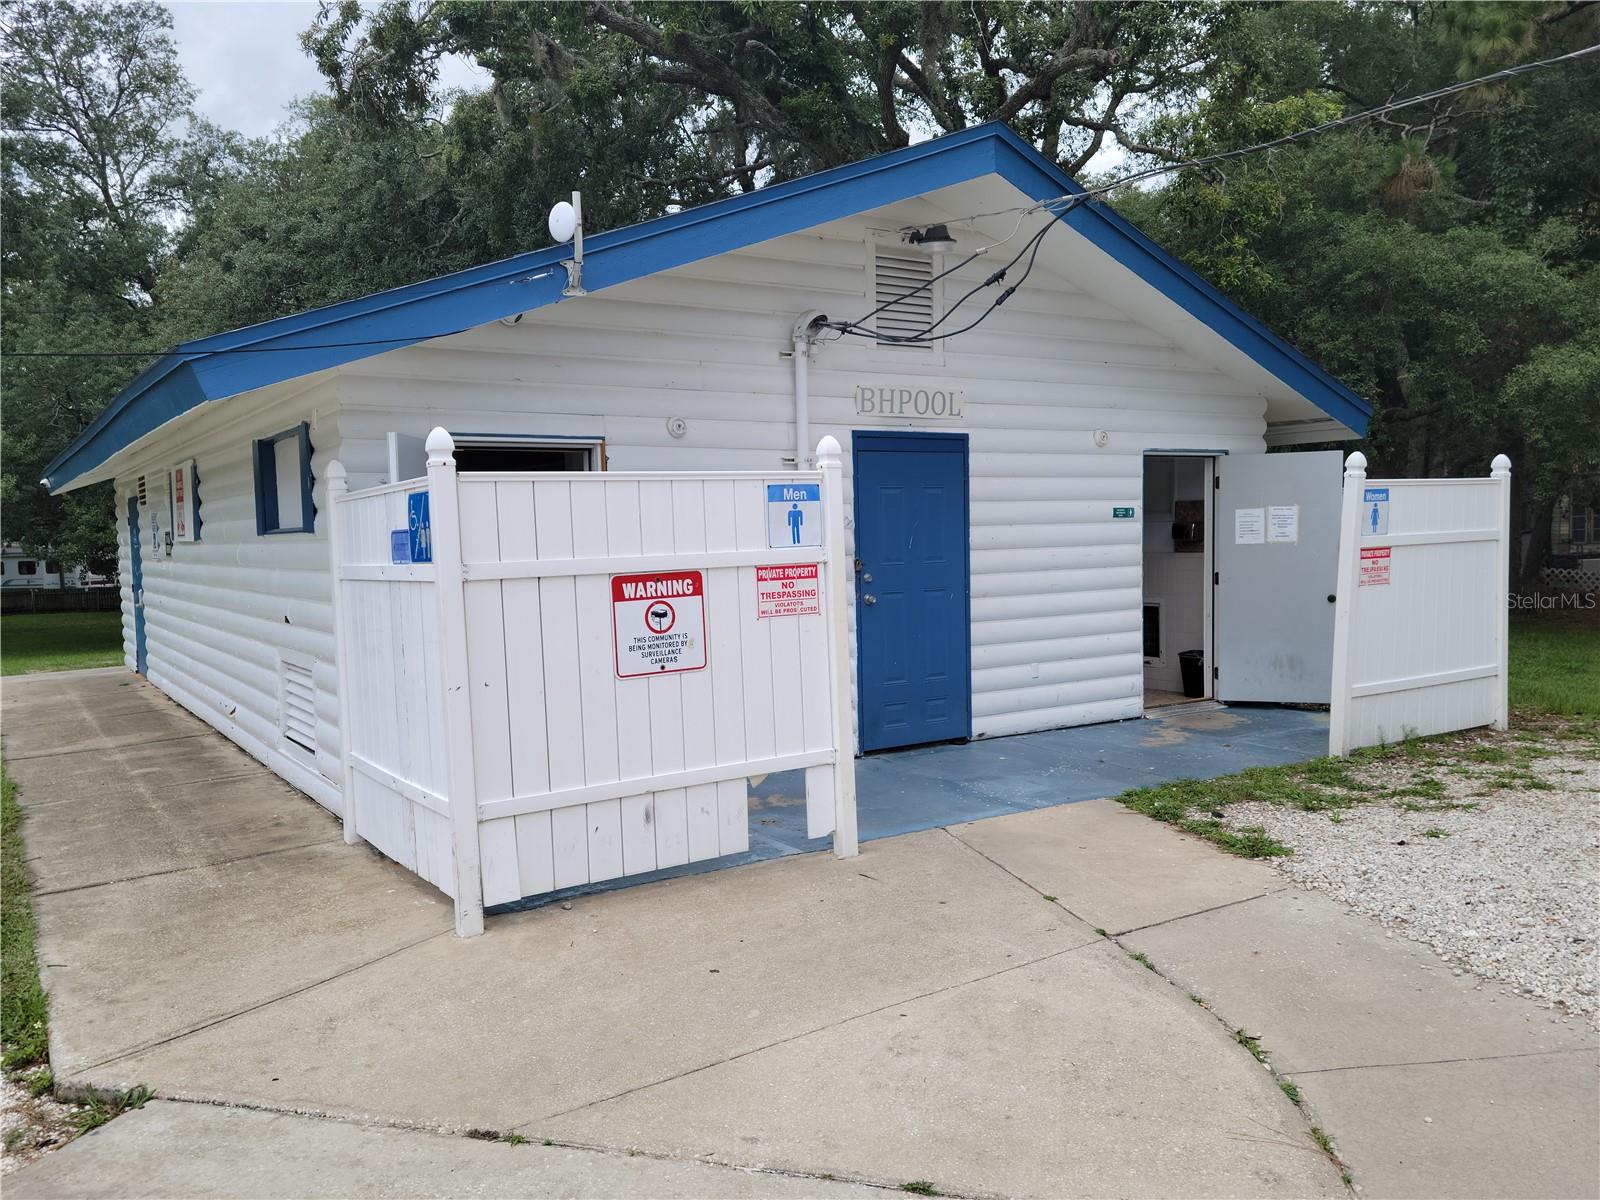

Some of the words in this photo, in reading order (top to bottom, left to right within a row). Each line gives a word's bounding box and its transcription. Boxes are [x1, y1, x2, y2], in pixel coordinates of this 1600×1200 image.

[859, 387, 961, 416] BHPOOL
[783, 488, 807, 500] Men
[1365, 491, 1387, 501] Women
[758, 569, 784, 580] PRIVATE
[785, 566, 816, 578] PROPERTY
[622, 579, 694, 599] WARNING
[760, 590, 816, 600] TRESPASSING
[648, 633, 681, 642] COMMUNITY
[628, 644, 646, 652] BEING
[647, 642, 679, 650] MONITORED
[641, 648, 682, 658] SURVEILLANCE
[650, 656, 678, 664] CAMERAS
